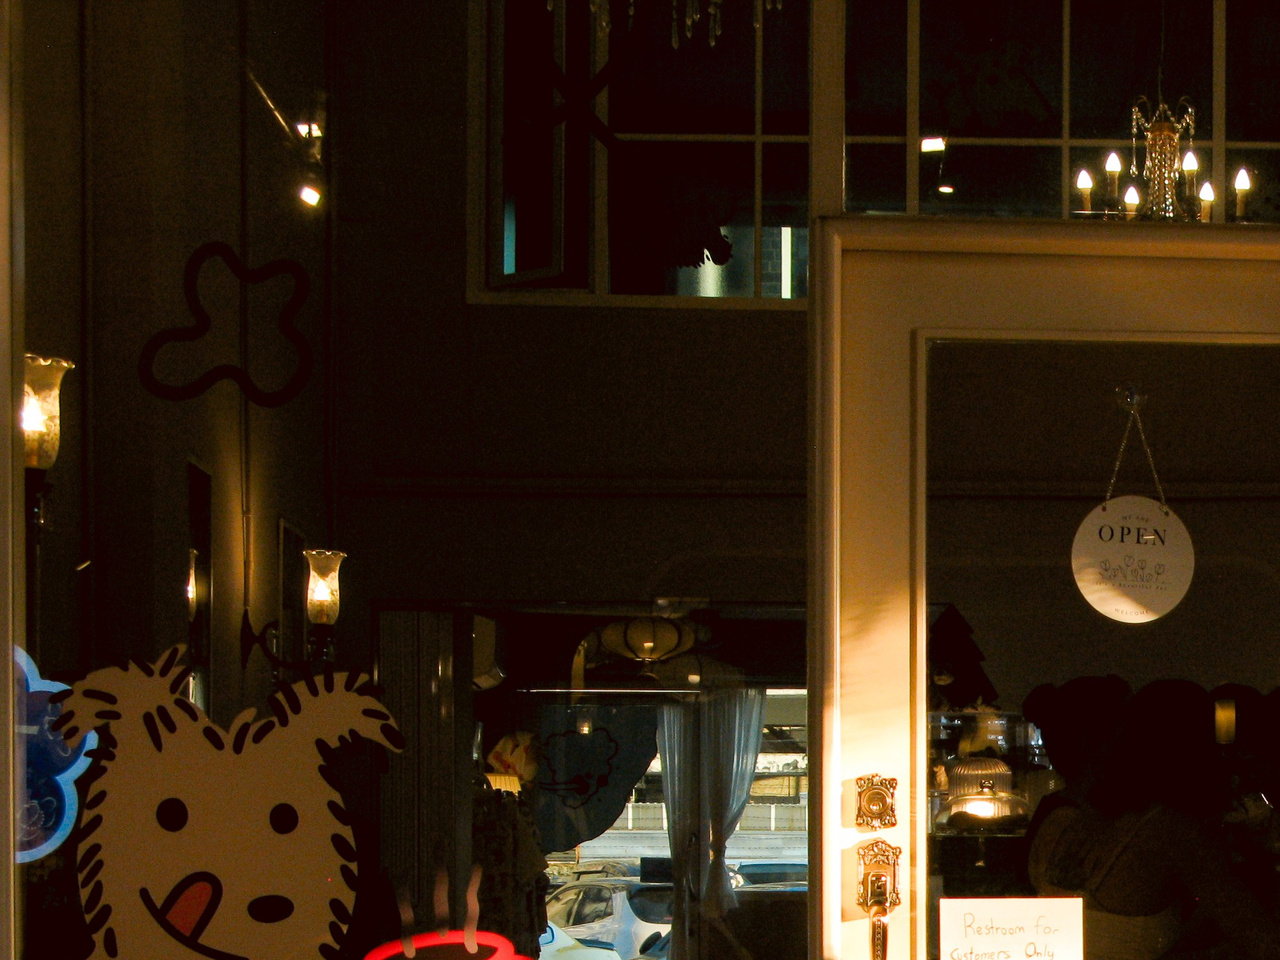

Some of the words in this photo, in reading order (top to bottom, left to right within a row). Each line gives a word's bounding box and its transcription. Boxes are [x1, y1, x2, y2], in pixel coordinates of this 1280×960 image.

[1098, 524, 1167, 546] OPEN
[1114, 607, 1151, 616] WELCOME
[963, 912, 1025, 938] Restroom
